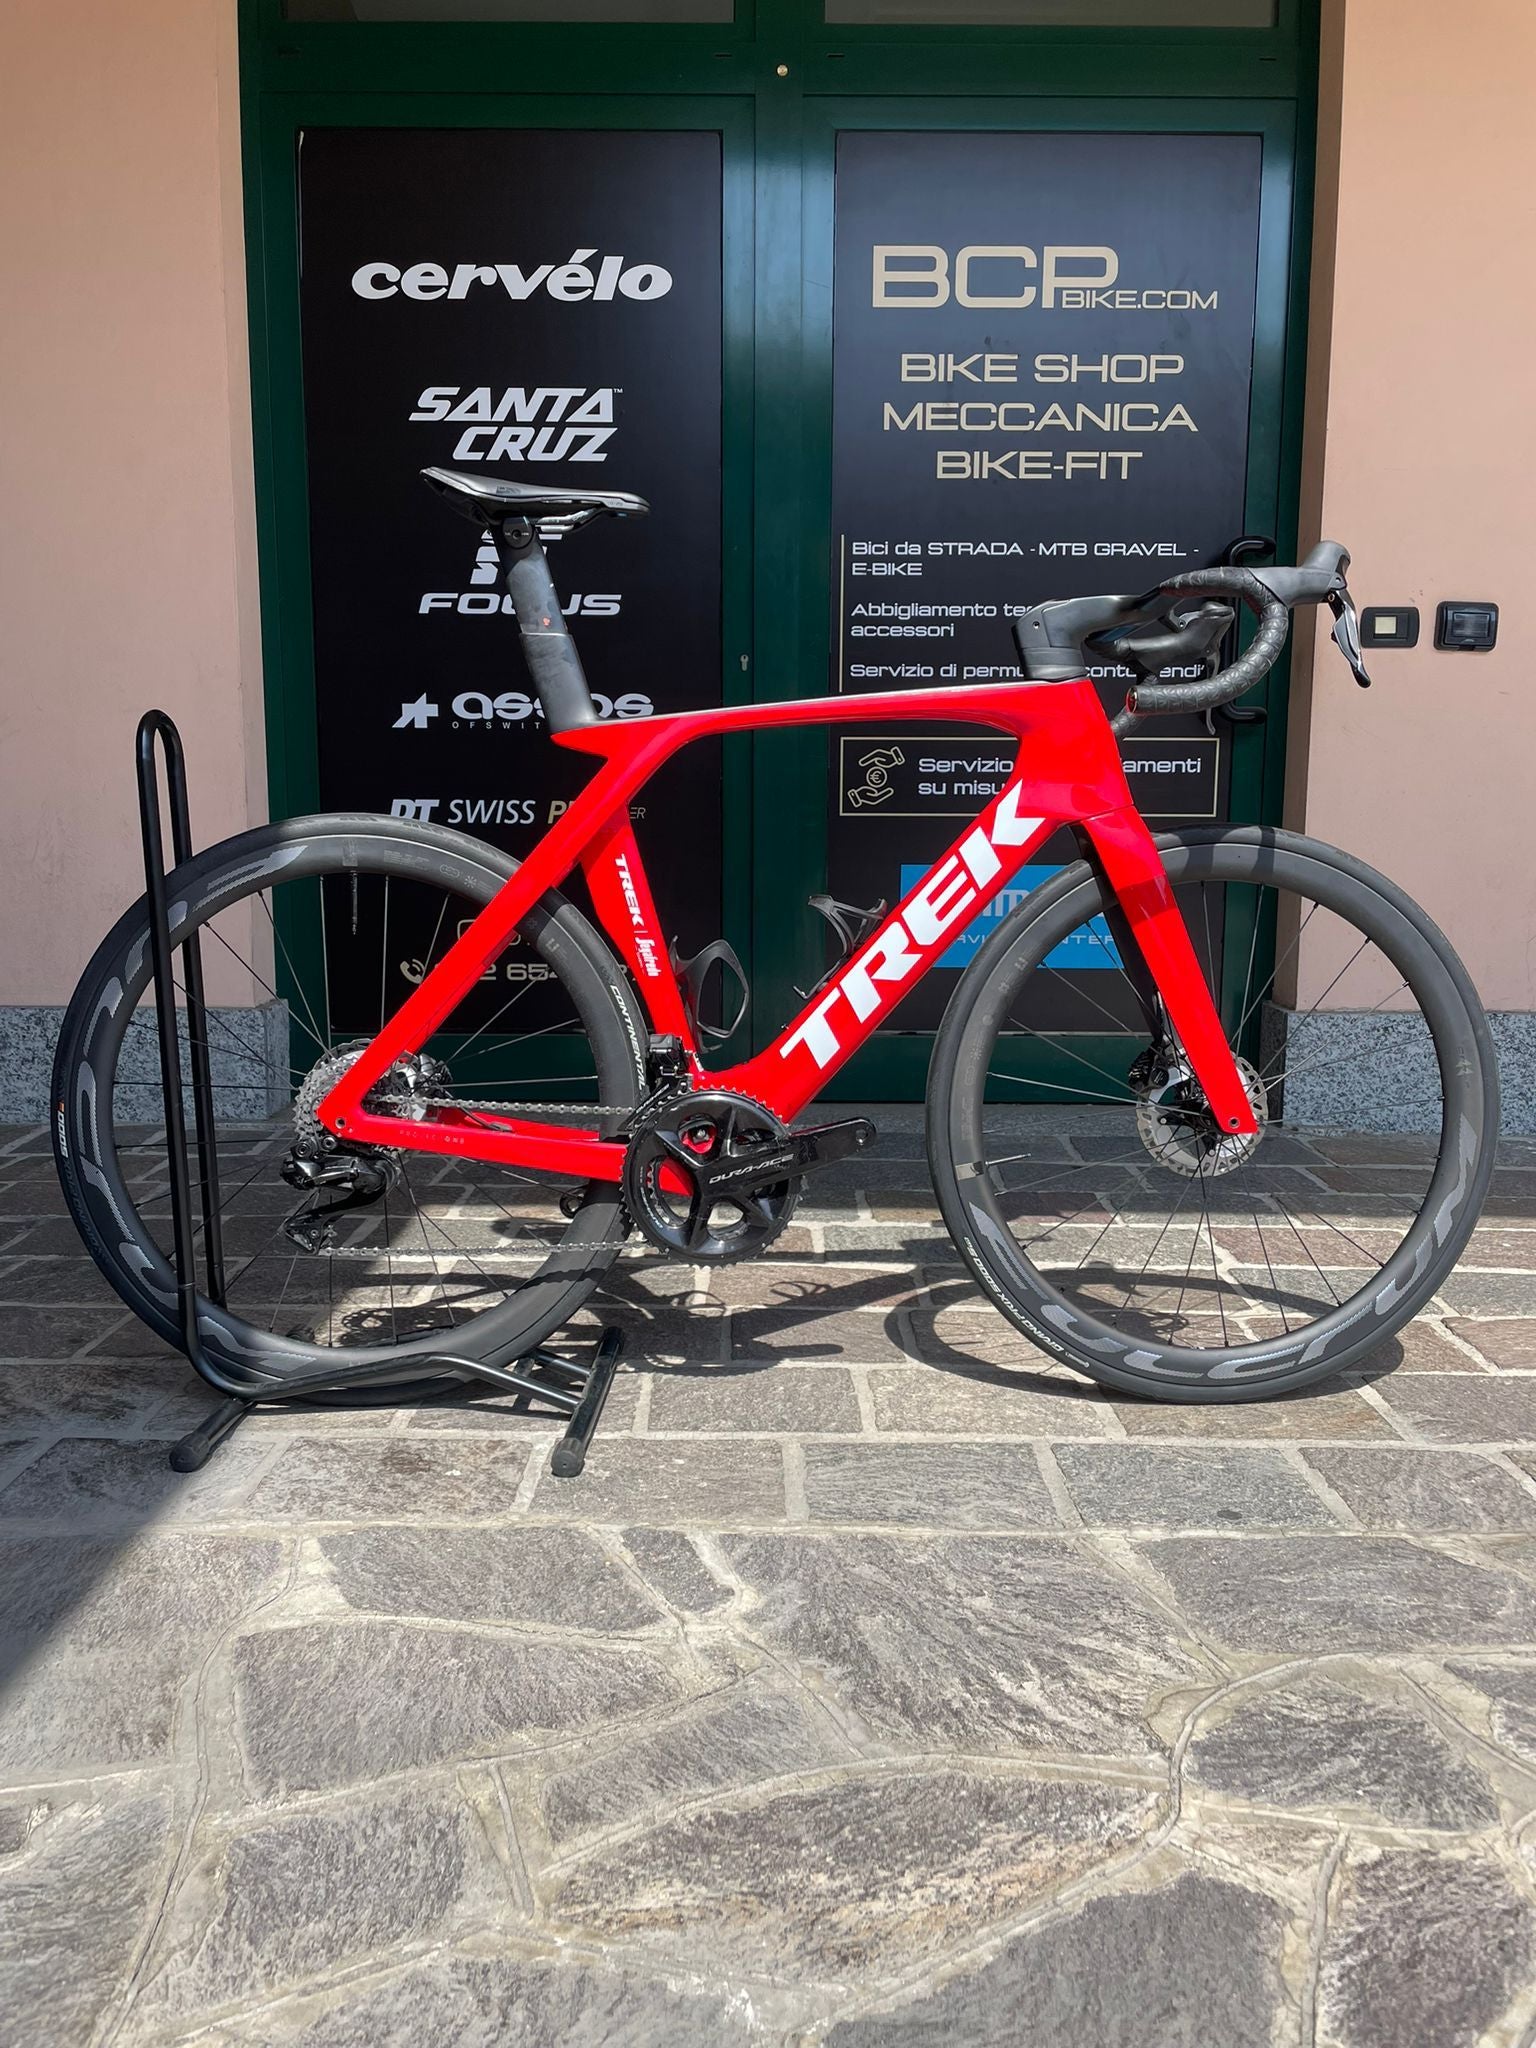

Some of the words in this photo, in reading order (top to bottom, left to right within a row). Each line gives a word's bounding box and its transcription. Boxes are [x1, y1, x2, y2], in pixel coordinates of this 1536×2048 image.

[351, 248, 673, 302] cervélo
[872, 245, 1119, 309] BCP
[1061, 289, 1218, 310] BIKE.COM
[901, 353, 1019, 383] BIKE
[1034, 354, 1185, 383] SHOP
[408, 387, 614, 422] SANTA
[883, 402, 1199, 432] MECCANICA
[452, 426, 618, 462] CRUZ
[936, 450, 1143, 480] BIKE-FIT
[852, 541, 889, 555] Bici
[894, 541, 922, 555] da
[927, 542, 1024, 556] STRADA
[1093, 543, 1187, 557] GRAVEL
[852, 562, 923, 576] E-BIKE
[418, 592, 622, 616] FOS
[851, 603, 997, 621] Abbigliamento
[850, 623, 955, 637] accessori
[850, 663, 934, 677] Servizio
[939, 663, 957, 677] di
[963, 666, 1024, 680] permu
[1085, 664, 1137, 678] ont
[451, 691, 655, 720] ass
[918, 757, 1014, 773] Servizio
[918, 782, 947, 795] su
[953, 780, 1006, 795] misu
[447, 799, 536, 824] SWISS
[614, 852, 645, 927] TREK
[780, 778, 1047, 1070] TREK
[609, 984, 646, 1091] CONTINENTAL
[708, 1153, 795, 1185] DURA-ACE
[972, 1257, 1002, 1293] 5000
[997, 1292, 1026, 1321] PRIX
[1021, 1319, 1065, 1352] GRAND
